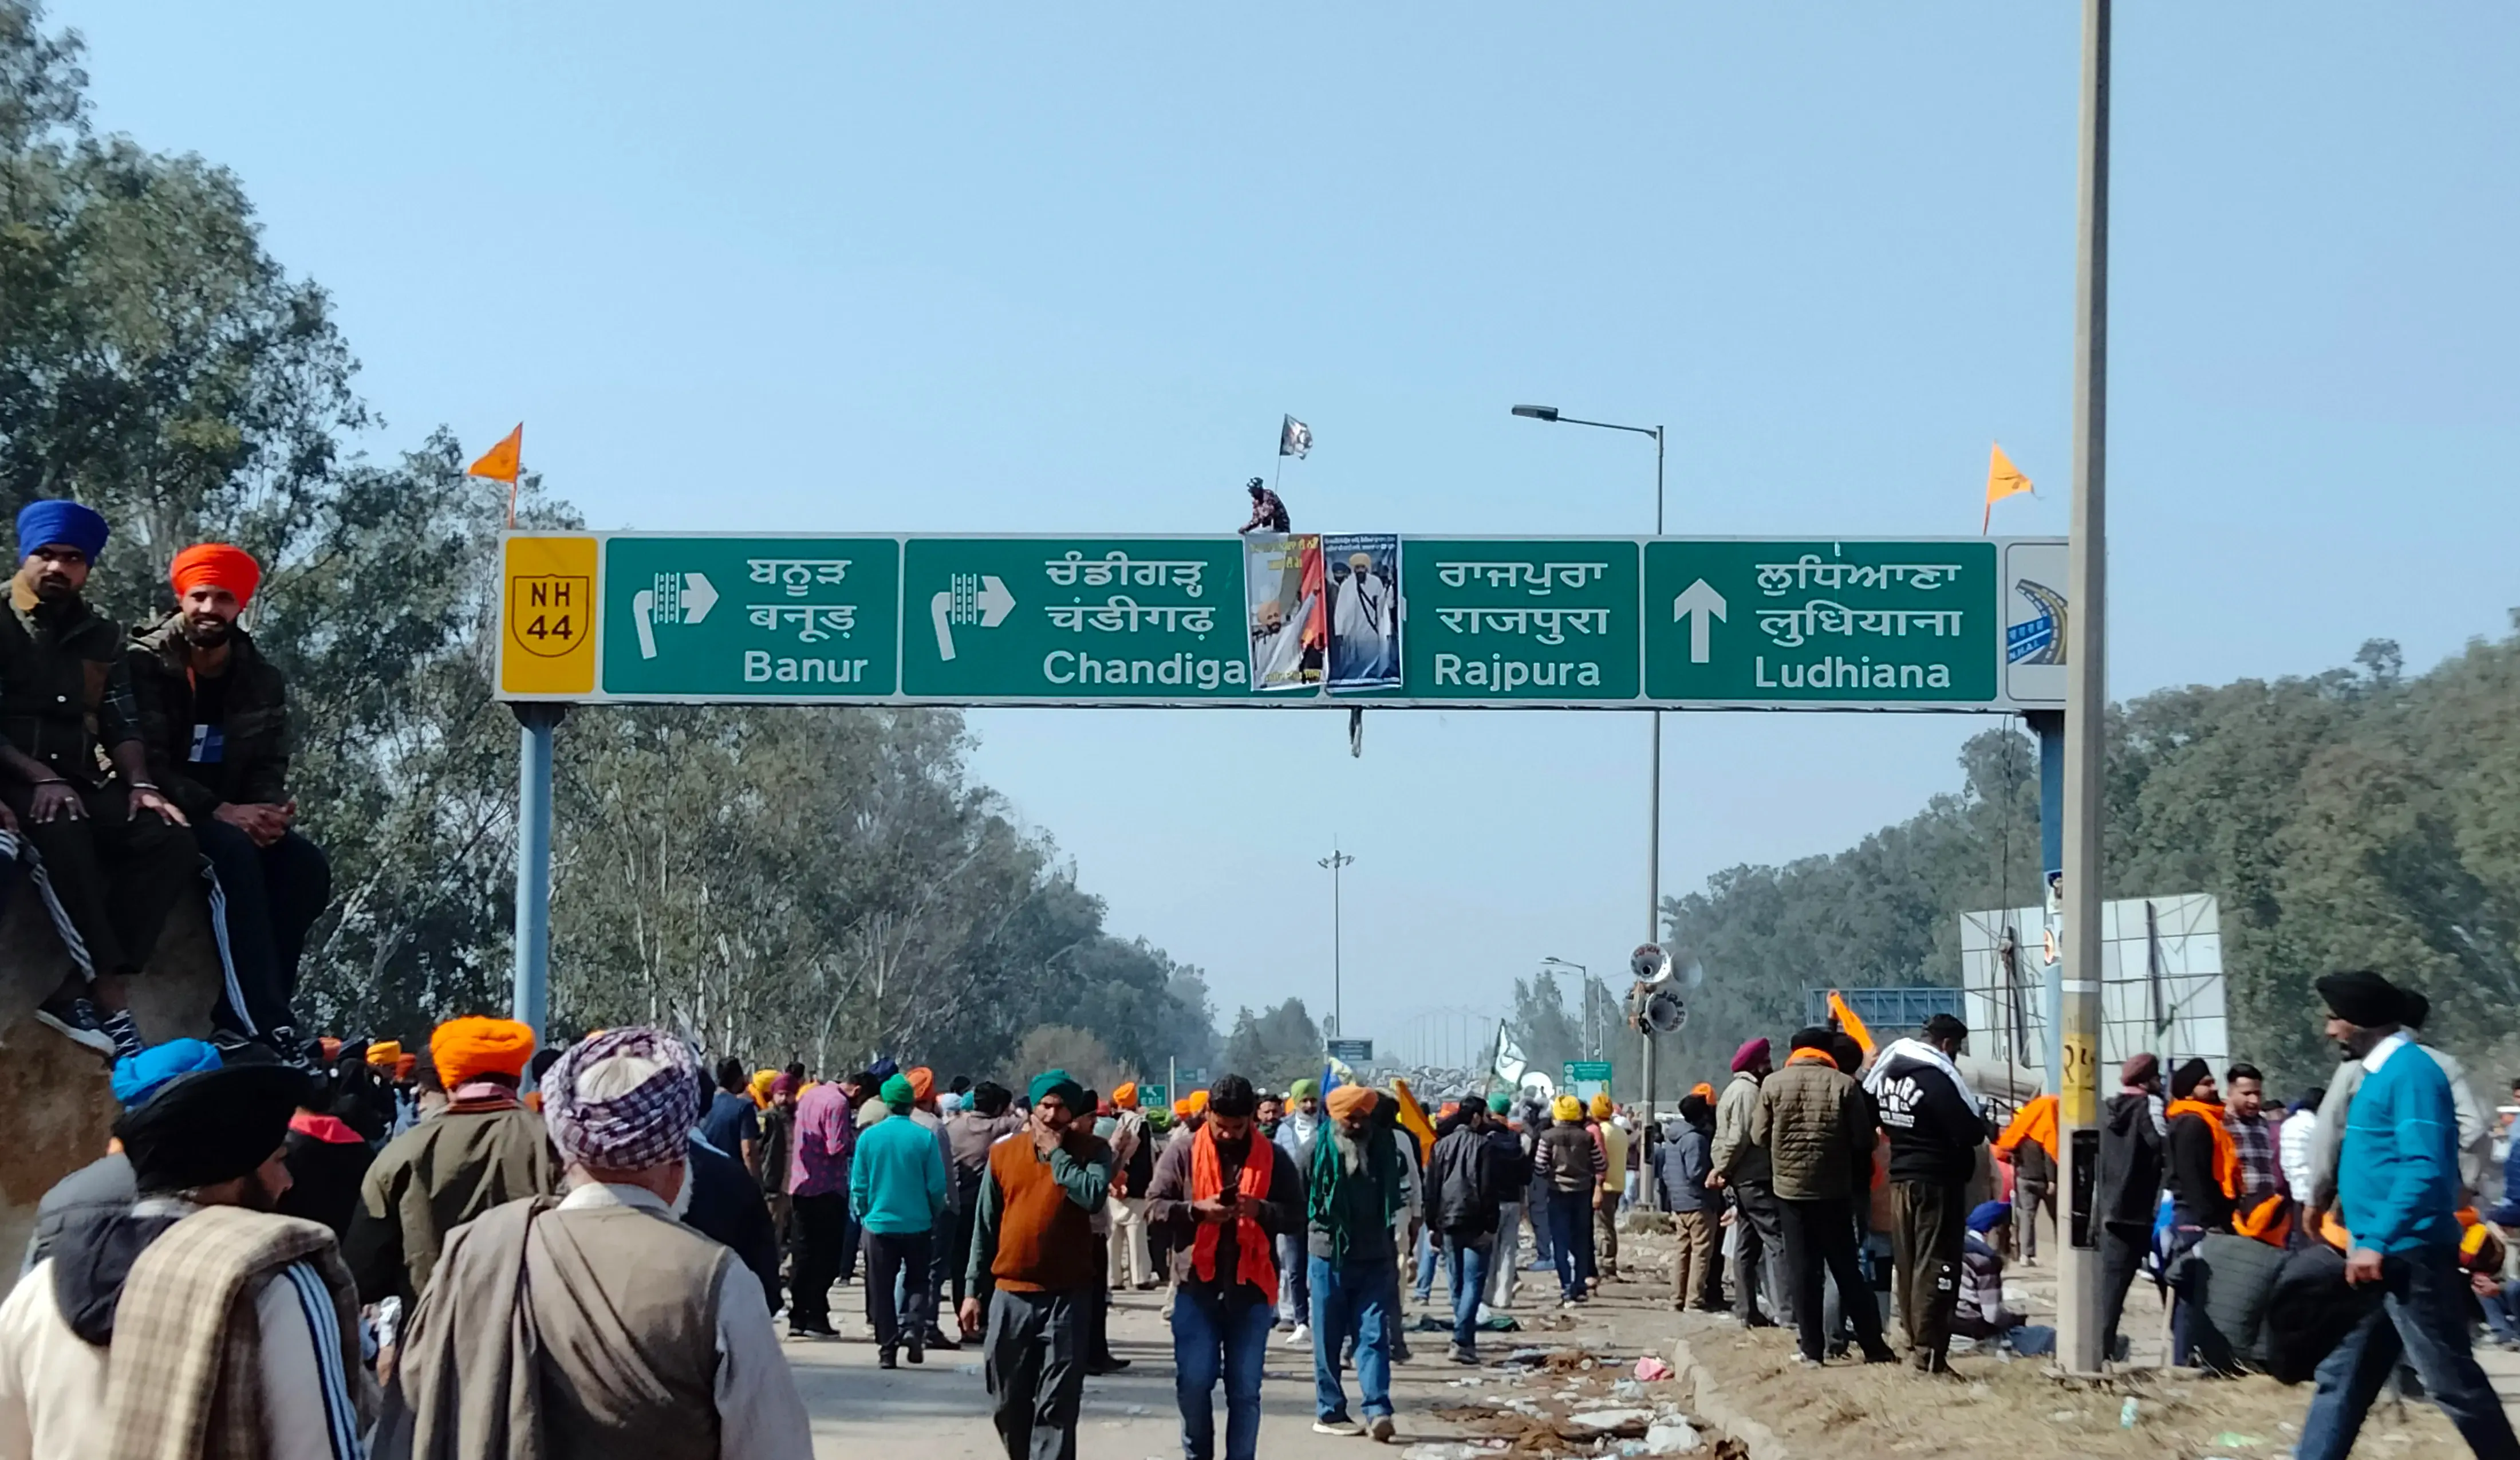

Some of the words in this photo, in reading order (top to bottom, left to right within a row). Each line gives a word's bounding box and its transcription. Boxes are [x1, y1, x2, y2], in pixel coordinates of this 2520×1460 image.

[747, 560, 852, 596] ਬਨੂੜ
[1045, 550, 1208, 597] ਚੰਡੀਗੜ੍ਹ
[1436, 562, 1608, 595] ਰਾਜਪੁਰਾ
[1755, 554, 1962, 596] ਲੁਧਿਆਣਾ
[531, 582, 570, 607] NH
[527, 615, 573, 640] 44
[746, 605, 857, 643] बनूड़
[1044, 595, 1216, 640] चंडीगढ़
[1436, 608, 1610, 644] राजपुरा
[1756, 600, 1963, 647] लुधियाना
[744, 651, 867, 682] Banur
[1044, 651, 1247, 690] Chandiga
[1436, 653, 1600, 691] Rajpura
[1756, 656, 1950, 688] Ludhiana
[1140, 1096, 1162, 1105] EXIT
